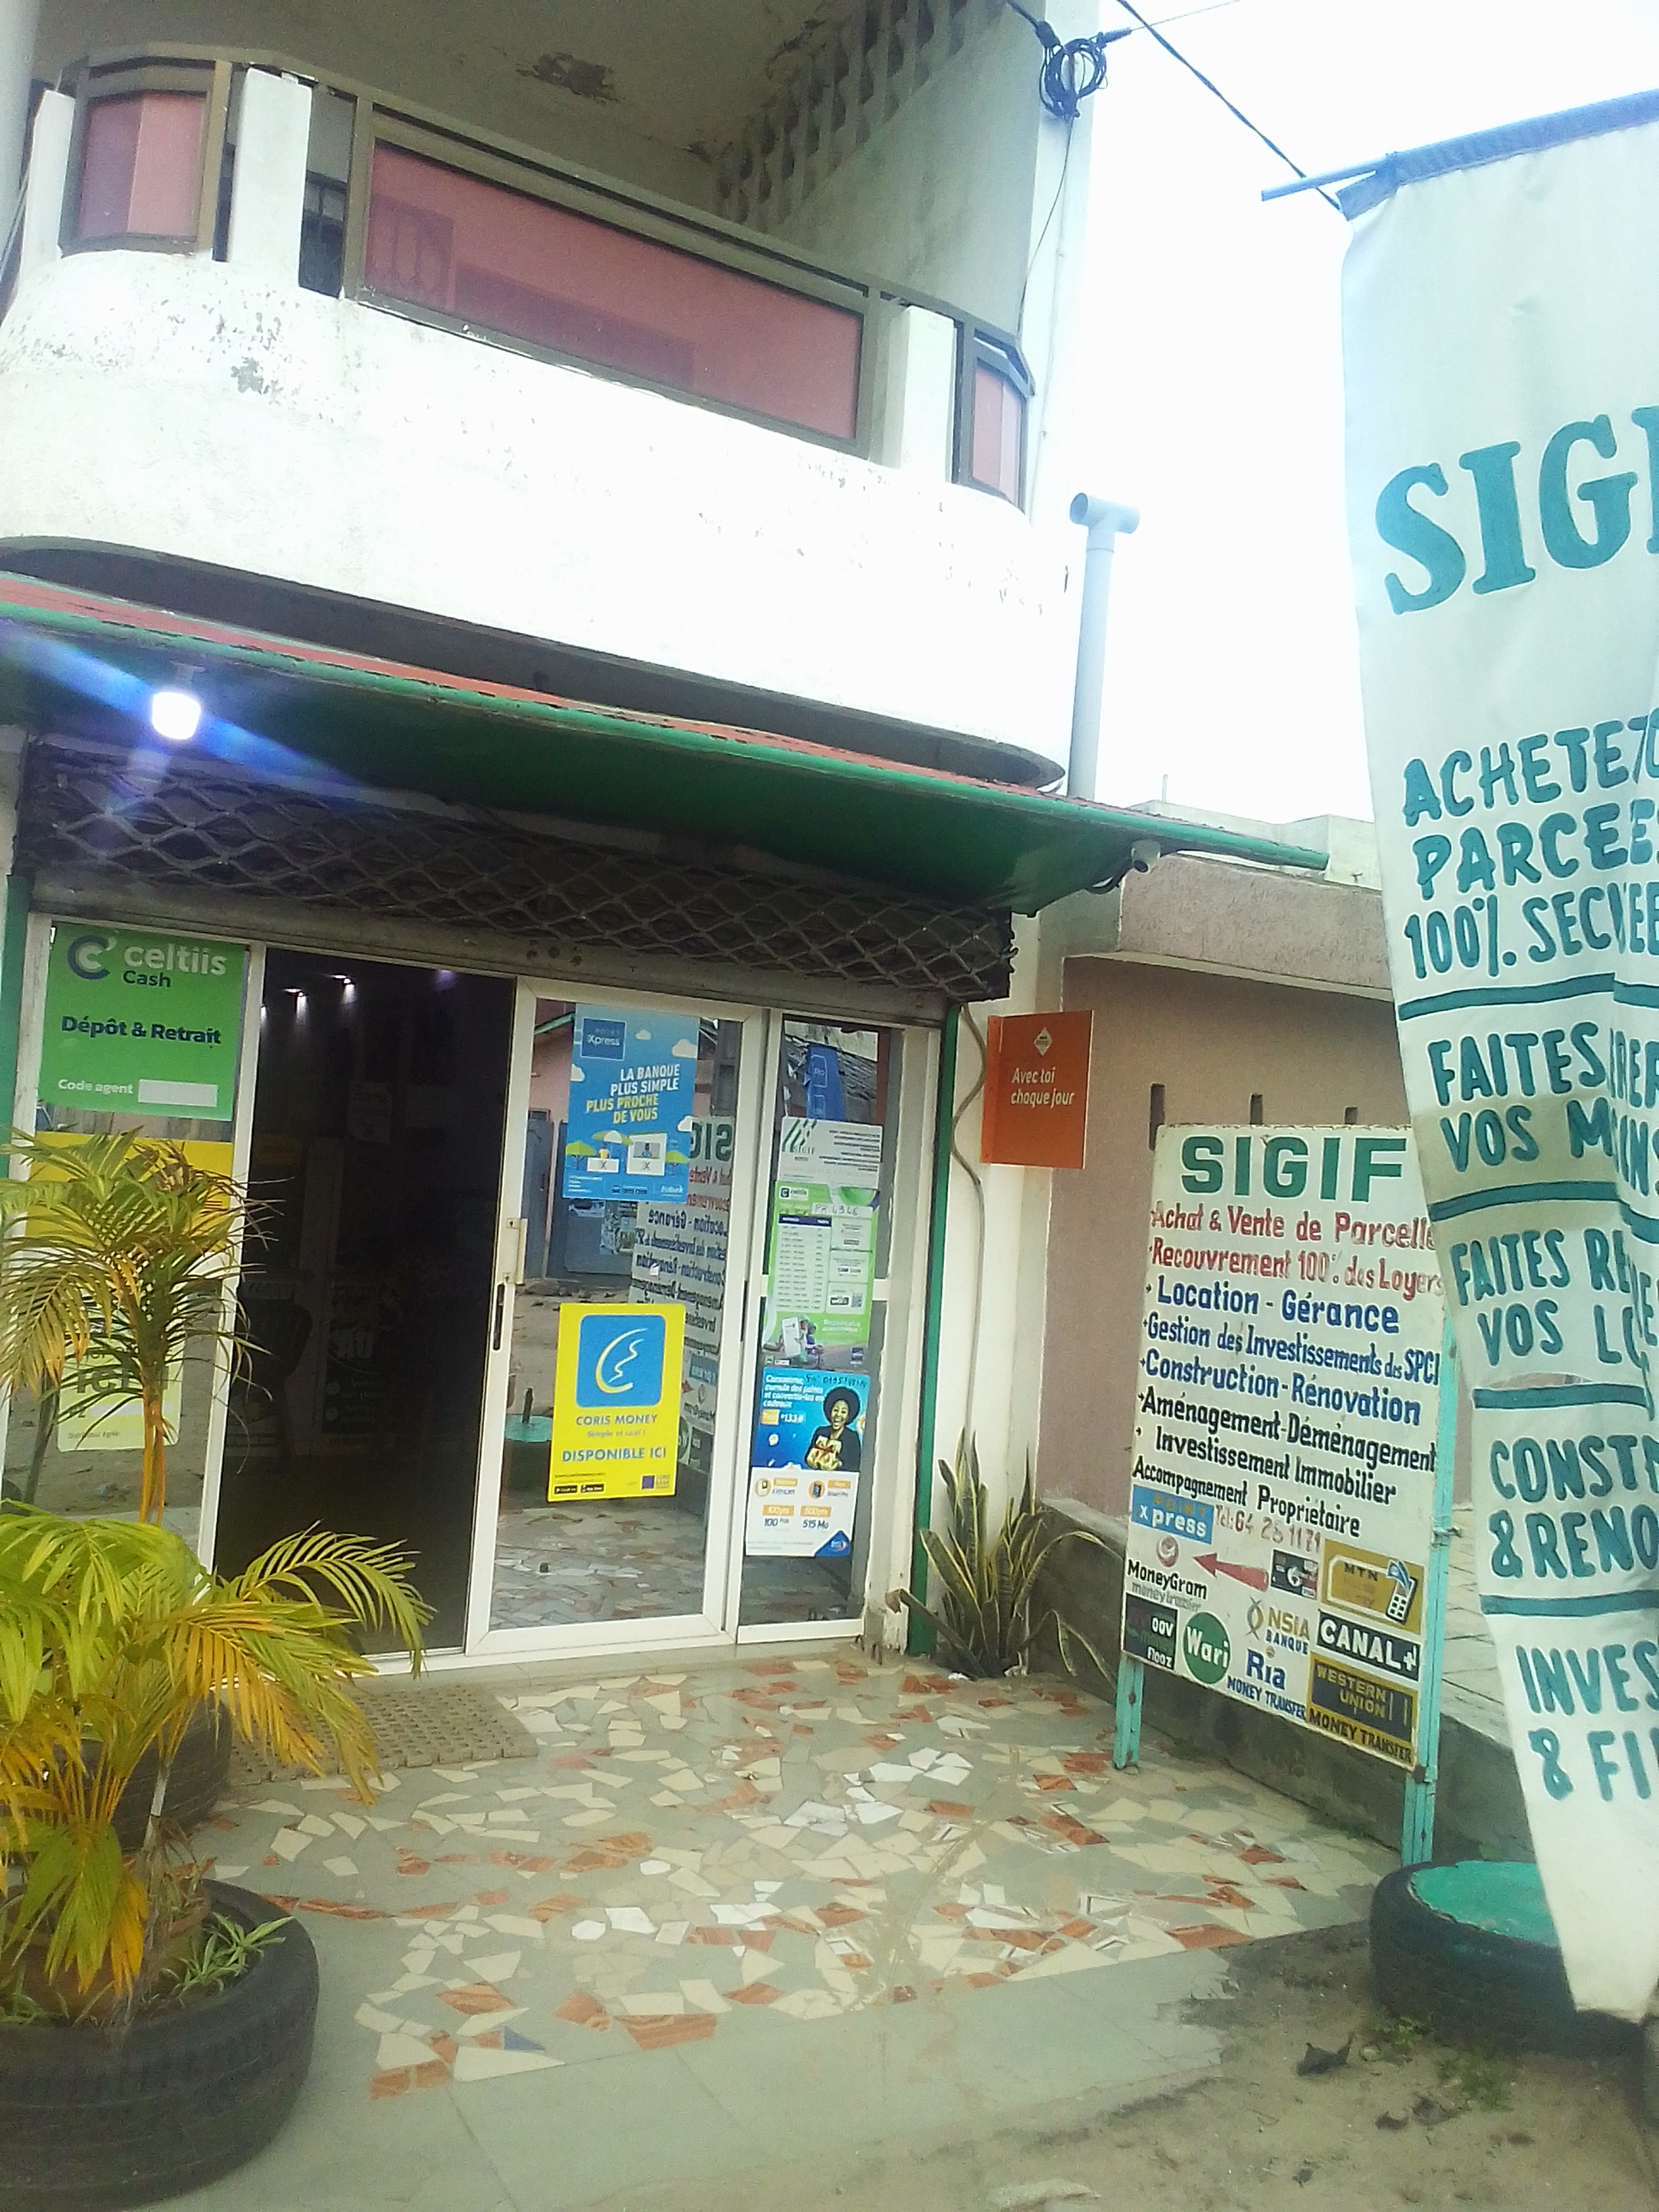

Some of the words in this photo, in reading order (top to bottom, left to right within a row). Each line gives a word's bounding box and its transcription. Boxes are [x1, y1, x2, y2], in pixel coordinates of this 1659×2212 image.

[123, 943, 228, 976] celtiis
[123, 970, 171, 988] Cash
[61, 1015, 127, 1038] Dépôt
[131, 1022, 147, 1038] &
[150, 1023, 222, 1044] Retrait
[621, 1068, 634, 1082] LA
[637, 1064, 680, 1080] BANQUE
[1012, 1067, 1038, 1084] Avec
[1040, 1066, 1056, 1083] toi
[1428, 1021, 1607, 1107] FAITES
[58, 1078, 94, 1092] Code
[95, 1082, 134, 1095] agent
[586, 1099, 614, 1113] PLUS
[617, 1094, 659, 1109] PROCHE
[610, 1082, 638, 1097] PLUS
[640, 1078, 679, 1092] SIMPLE
[1011, 1088, 1049, 1108] chaque
[1050, 1088, 1076, 1109] jour
[613, 1111, 627, 1124] DE
[630, 1107, 658, 1122] VOUS
[1440, 1105, 1540, 1173] VOS
[1181, 1136, 1407, 1202] SIGIF
[1151, 1200, 1204, 1231] Achat
[1209, 1210, 1222, 1231] &
[1227, 1205, 1284, 1237] Vente
[1296, 1212, 1322, 1241] de
[1152, 1237, 1291, 1278] Recouvrement
[1345, 1255, 1375, 1289] des
[1450, 1229, 1571, 1306] FAITES
[1158, 1275, 1258, 1315] Location
[1281, 1289, 1399, 1333] Gérance
[1147, 1312, 1210, 1348] Gestion
[1217, 1322, 1243, 1353] des
[1247, 1324, 1382, 1375] Investissements
[1477, 1298, 1564, 1366] VOS
[576, 1416, 611, 1426] CORIS
[615, 1414, 658, 1425] MONEY
[562, 1448, 644, 1462] DISPONIBLE
[651, 1446, 666, 1458] ICI
[1155, 1426, 1290, 1481] Investissement
[1295, 1456, 1397, 1504] Immobilier
[1132, 1456, 1248, 1506] Accompagnement
[1128, 1559, 1207, 1599] MoneyGram
[1344, 1561, 1378, 1582] MTN
[1265, 1629, 1309, 1655] BANQUE
[1268, 1607, 1309, 1640] NSIA
[1187, 1626, 1229, 1668] Wari
[1321, 1618, 1418, 1672] CANAL+
[1246, 1648, 1286, 1690] Ria
[1316, 1664, 1387, 1702] WESTERN
[1227, 1676, 1263, 1706] MONEY
[1265, 1690, 1306, 1719] TRANSFER
[1340, 1690, 1385, 1718] UNION
[1309, 1708, 1357, 1740] MONEY
[1360, 1728, 1412, 1763] TRANSFER
[1528, 1727, 1574, 1801] &
